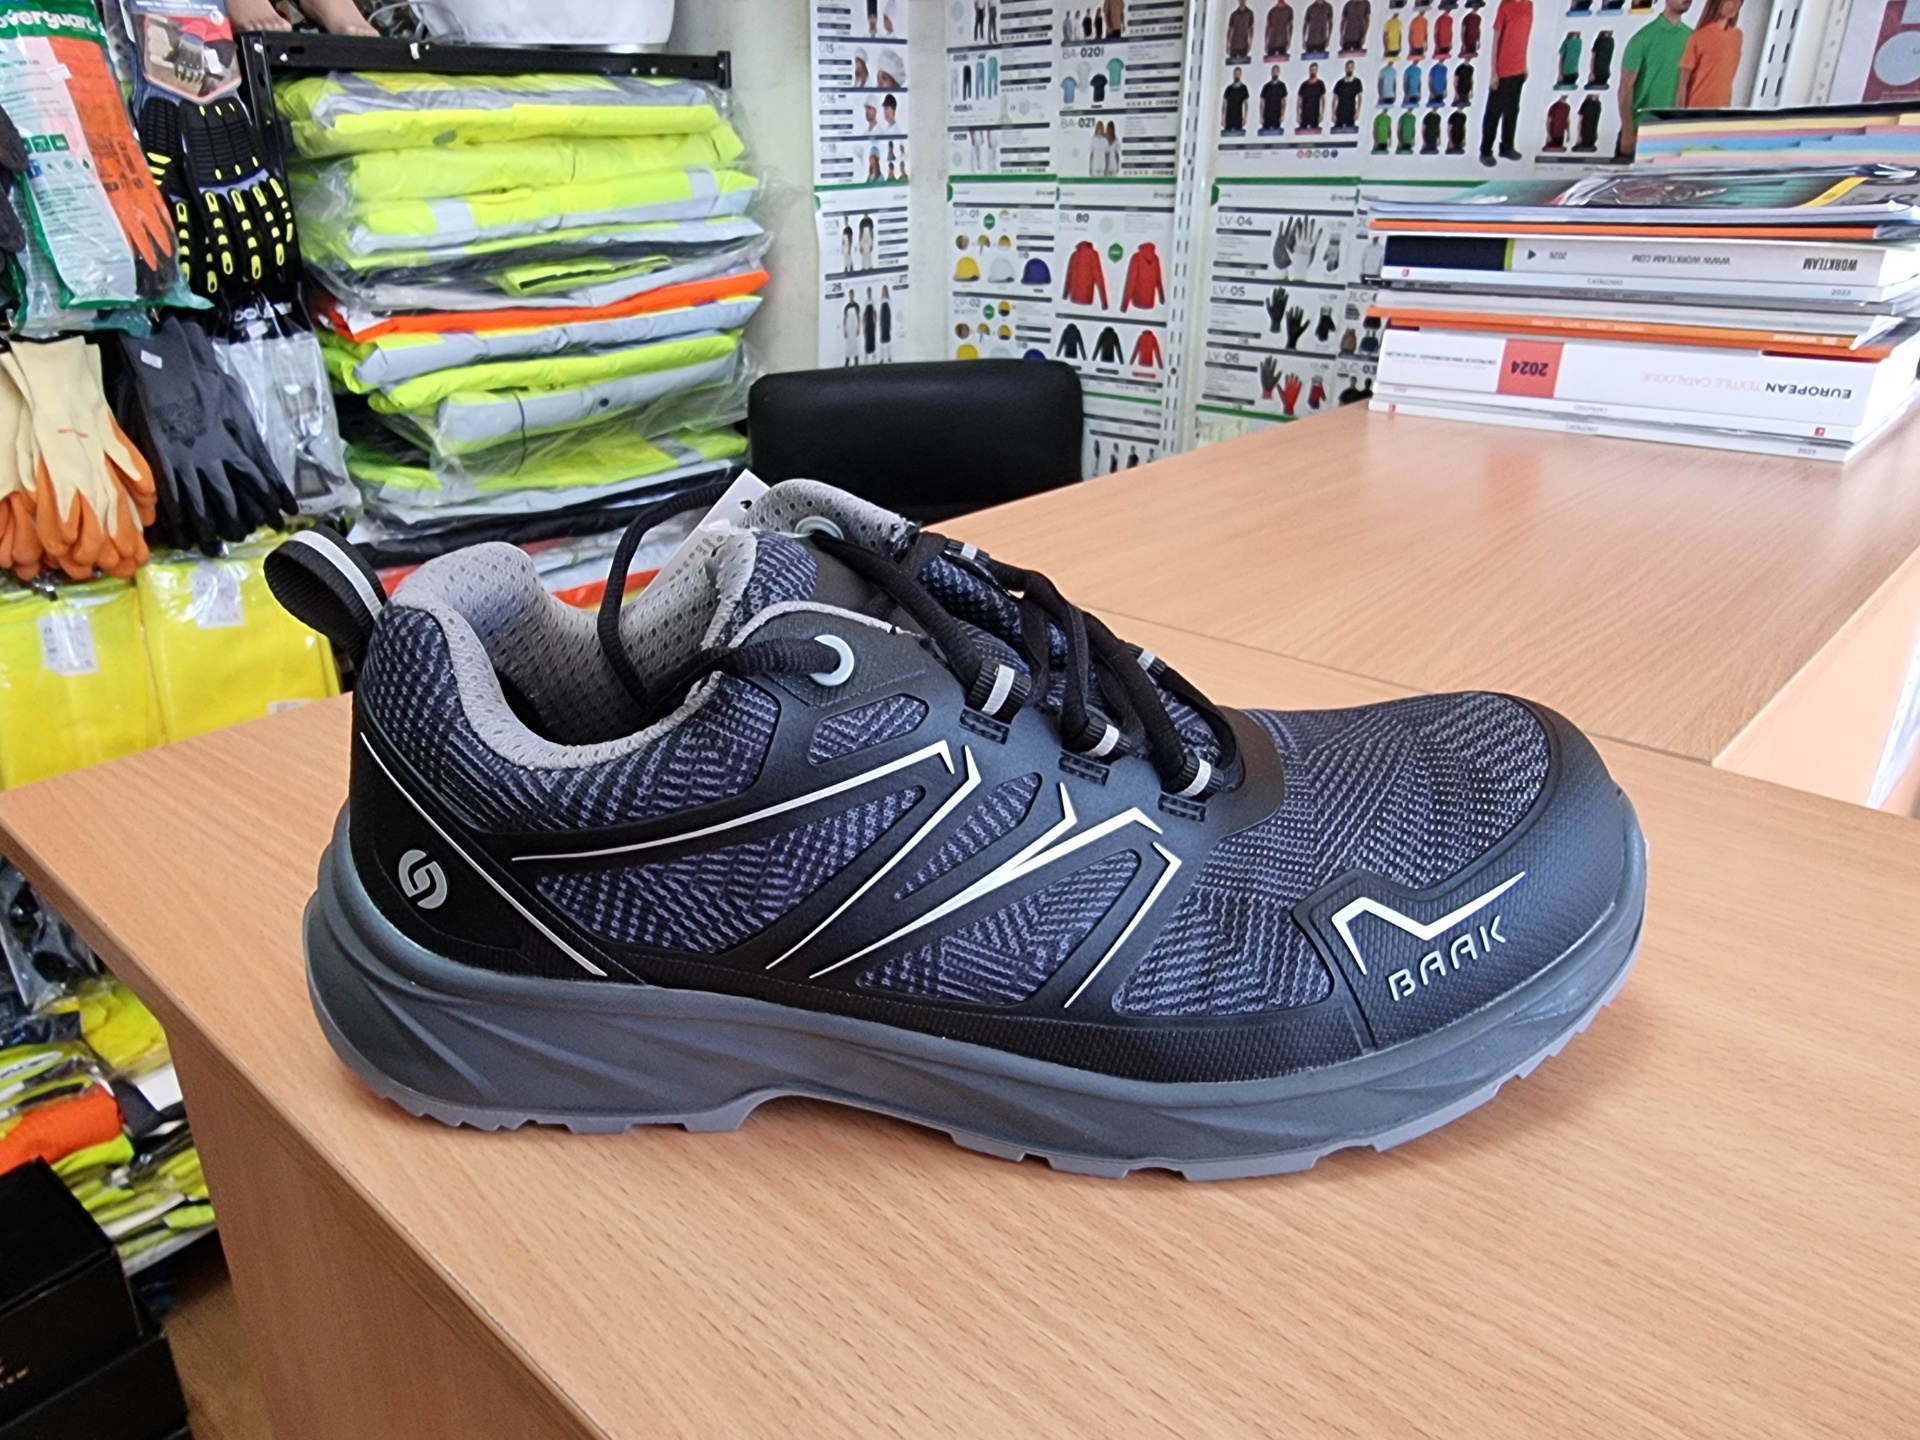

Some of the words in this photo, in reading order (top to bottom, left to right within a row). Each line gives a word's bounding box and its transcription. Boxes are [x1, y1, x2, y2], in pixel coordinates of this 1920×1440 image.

[1803, 257, 1859, 272] WORKTEAM
[1510, 360, 1549, 376] 2024
[1765, 382, 1852, 399] EUROPEAN
[1388, 915, 1506, 1001] BAAK
